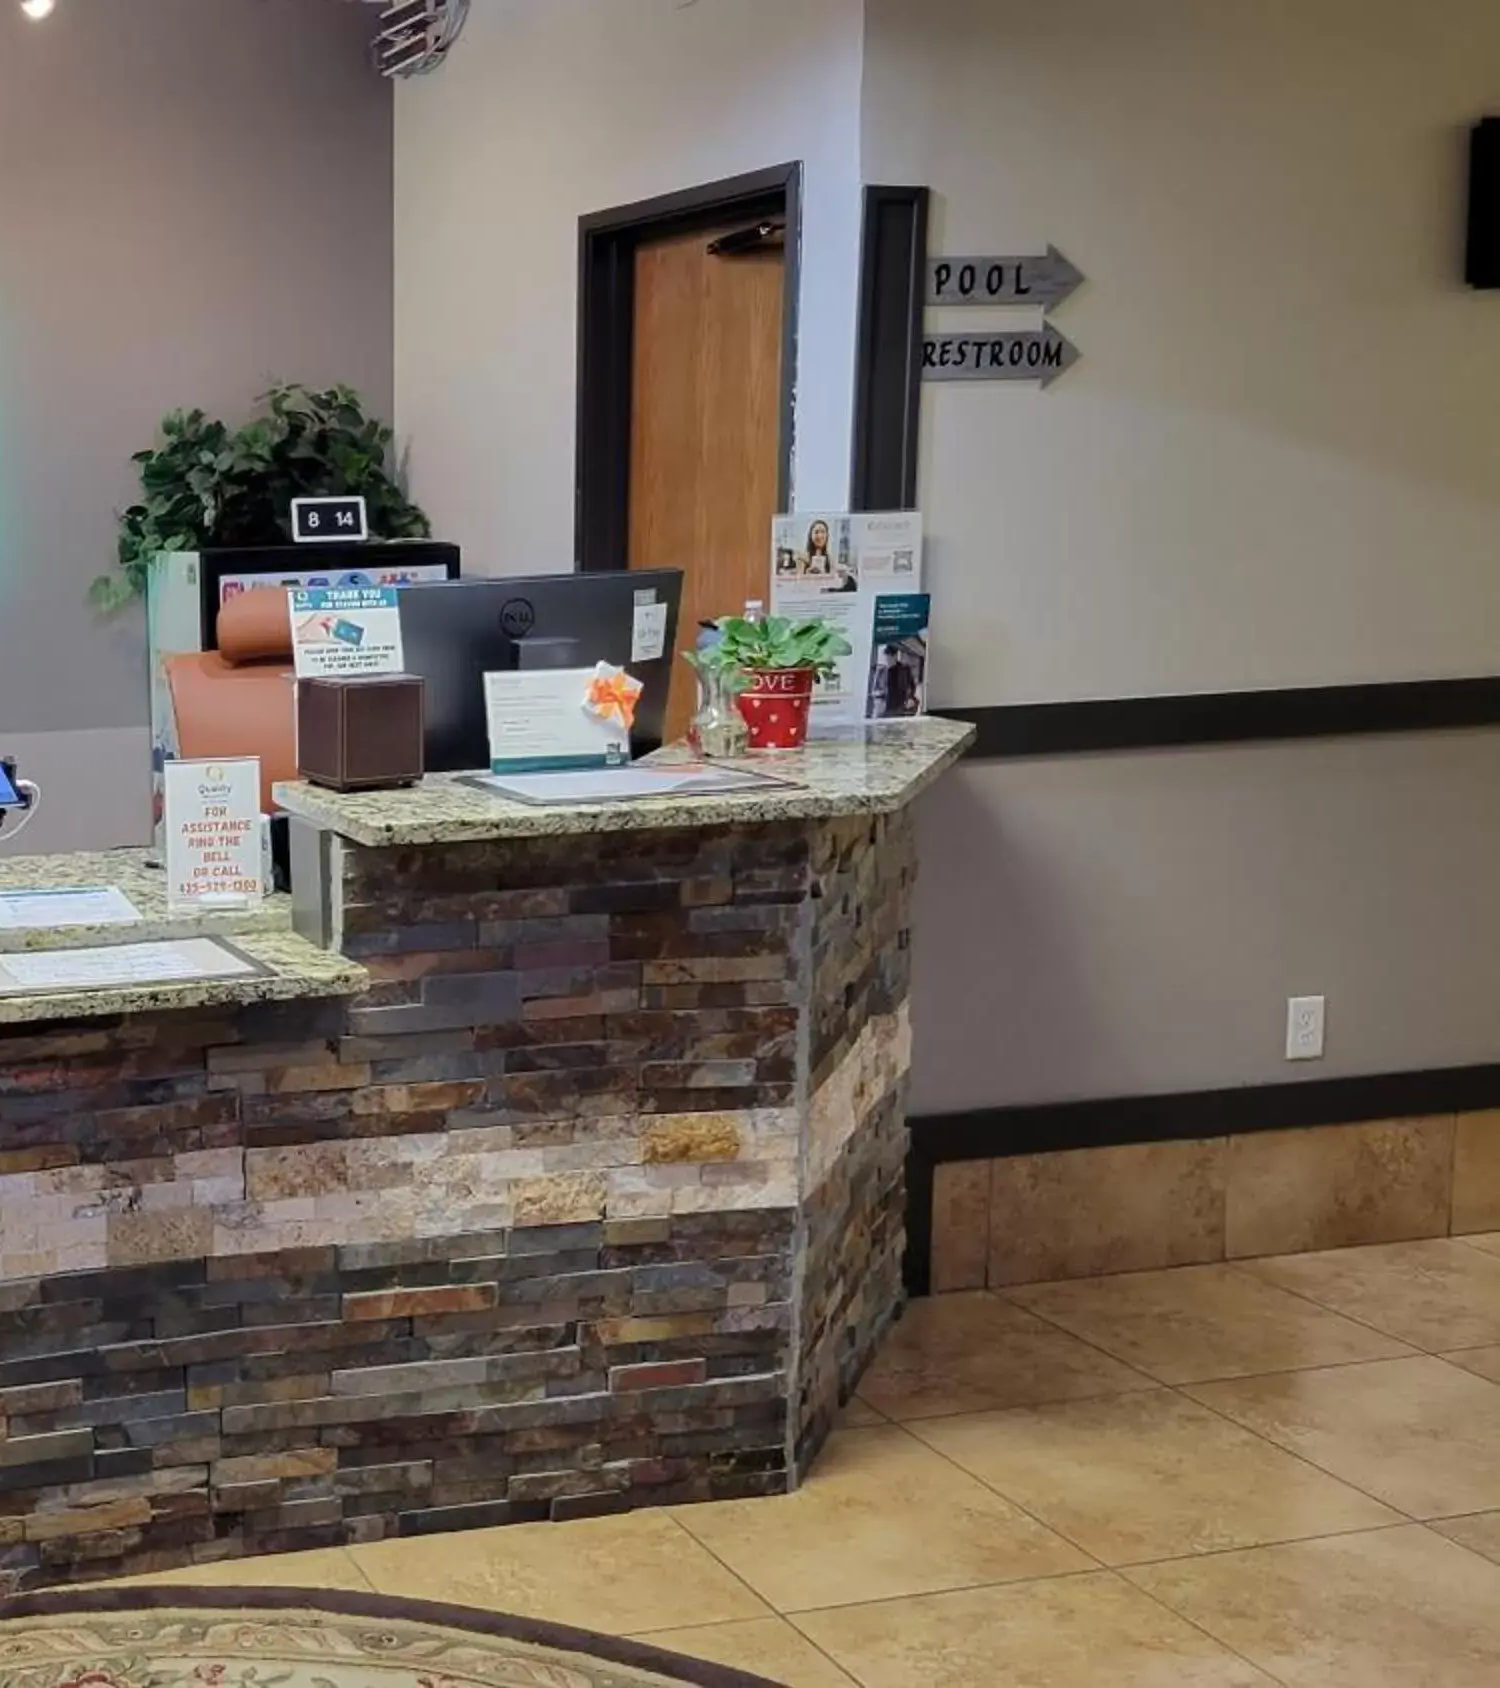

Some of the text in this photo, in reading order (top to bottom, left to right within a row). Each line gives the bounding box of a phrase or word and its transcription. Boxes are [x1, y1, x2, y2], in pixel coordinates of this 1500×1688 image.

[934, 262, 1031, 295] POOL
[921, 340, 1063, 368] RESTROOM
[307, 511, 353, 527] 8 14
[753, 674, 796, 690] OVE
[205, 806, 227, 817] FOR
[182, 820, 252, 834] ASSISTANCE
[219, 836, 241, 847] THE
[203, 851, 231, 862] BELL
[213, 865, 243, 876] CALL
